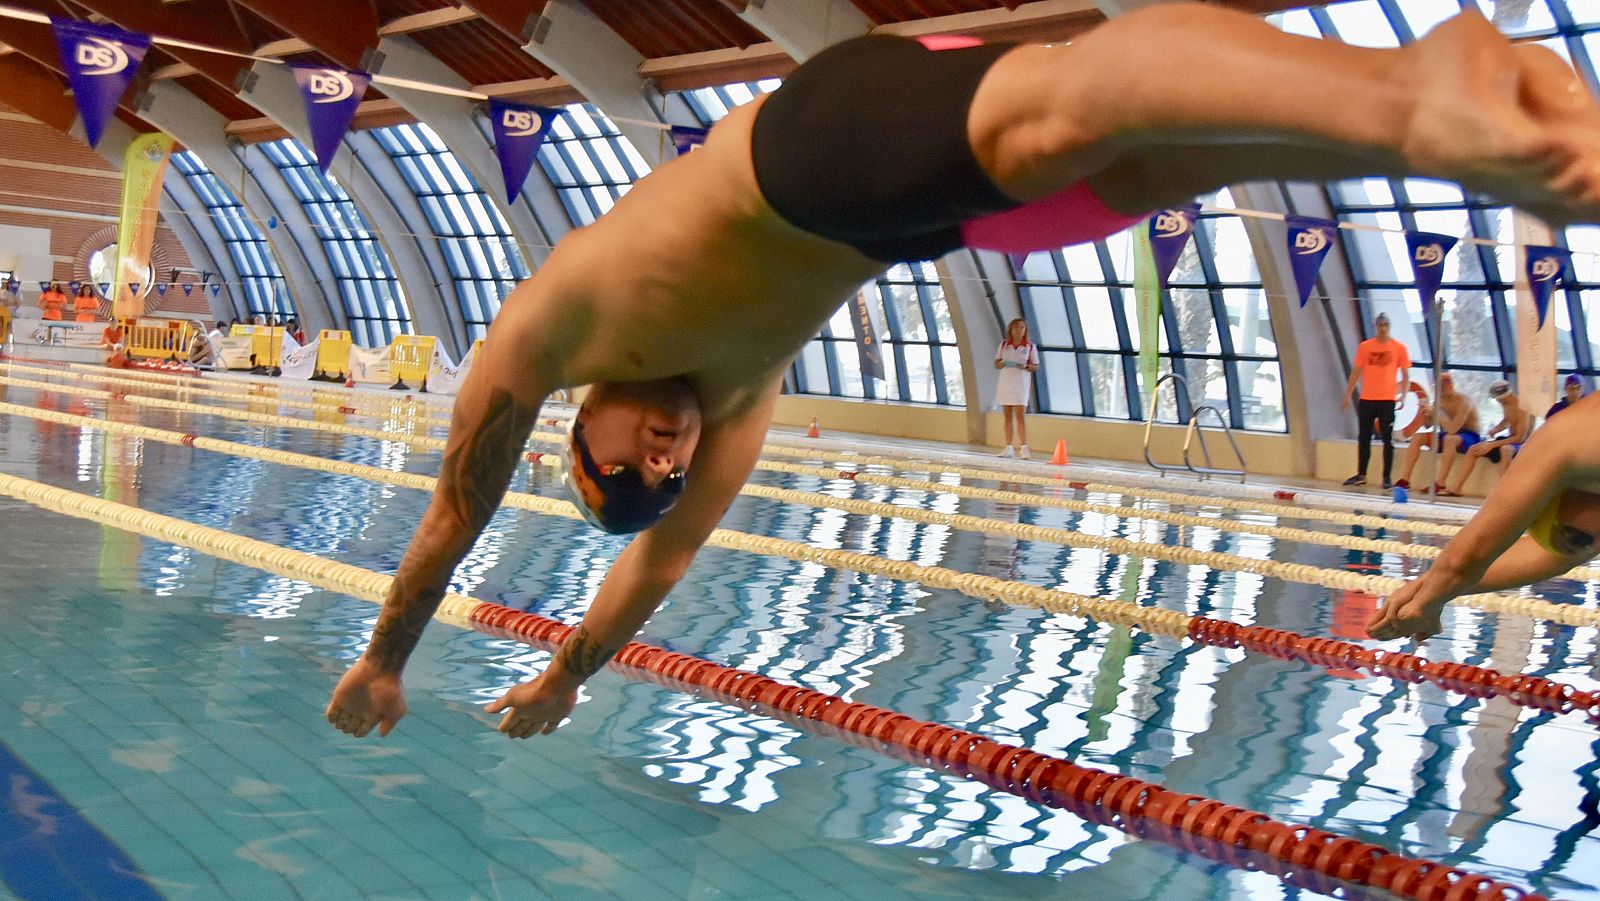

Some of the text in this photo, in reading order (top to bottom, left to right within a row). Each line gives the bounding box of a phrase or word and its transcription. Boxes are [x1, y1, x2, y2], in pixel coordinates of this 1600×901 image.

[78, 44, 114, 68] DS
[311, 75, 341, 96] DS
[502, 109, 533, 130] DS
[1155, 214, 1179, 232] DS
[1295, 232, 1318, 249] DS
